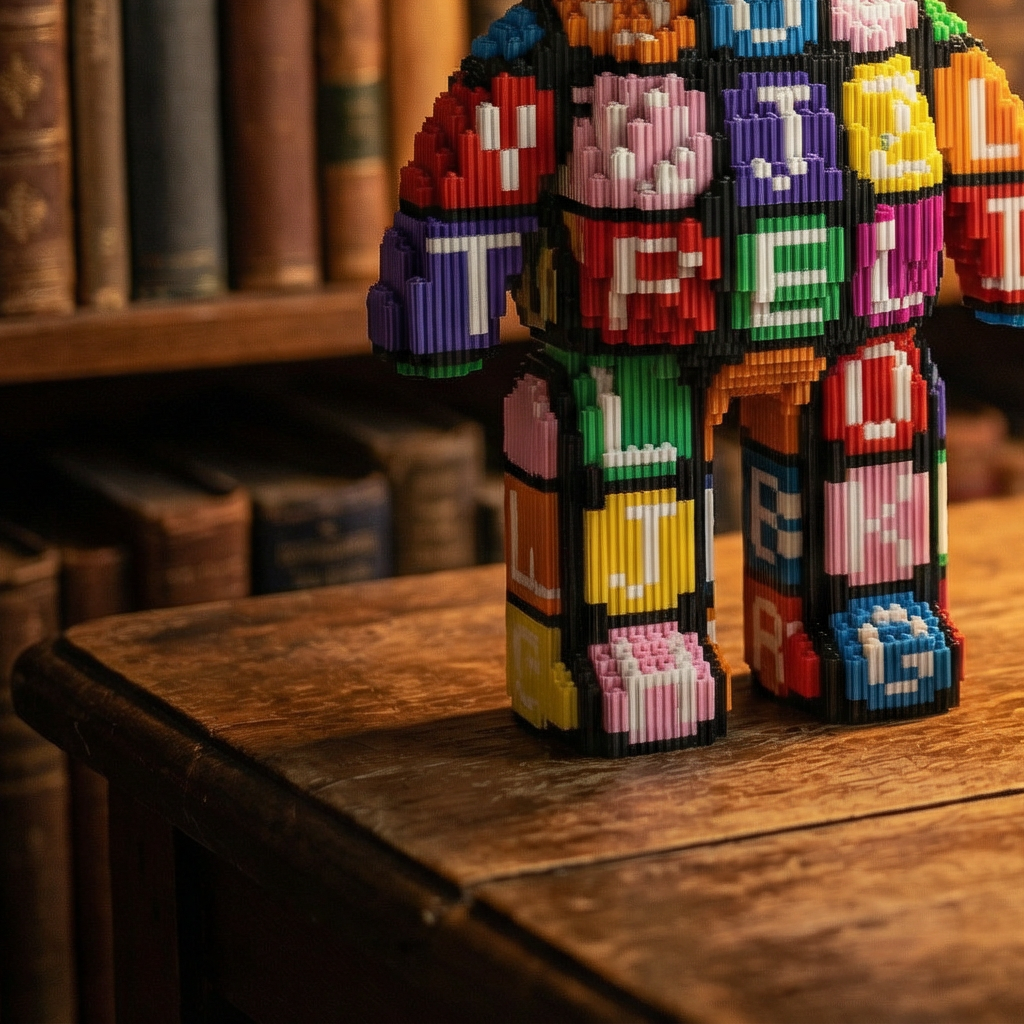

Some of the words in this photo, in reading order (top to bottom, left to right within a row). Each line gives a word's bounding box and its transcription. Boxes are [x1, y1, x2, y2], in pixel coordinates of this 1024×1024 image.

[475, 102, 537, 192] Y
[967, 77, 1019, 161] L
[425, 232, 522, 336] T
[750, 227, 828, 328] E
[870, 218, 924, 314] L
[590, 366, 678, 468] L
[610, 502, 678, 600] J
[846, 474, 914, 574] K
